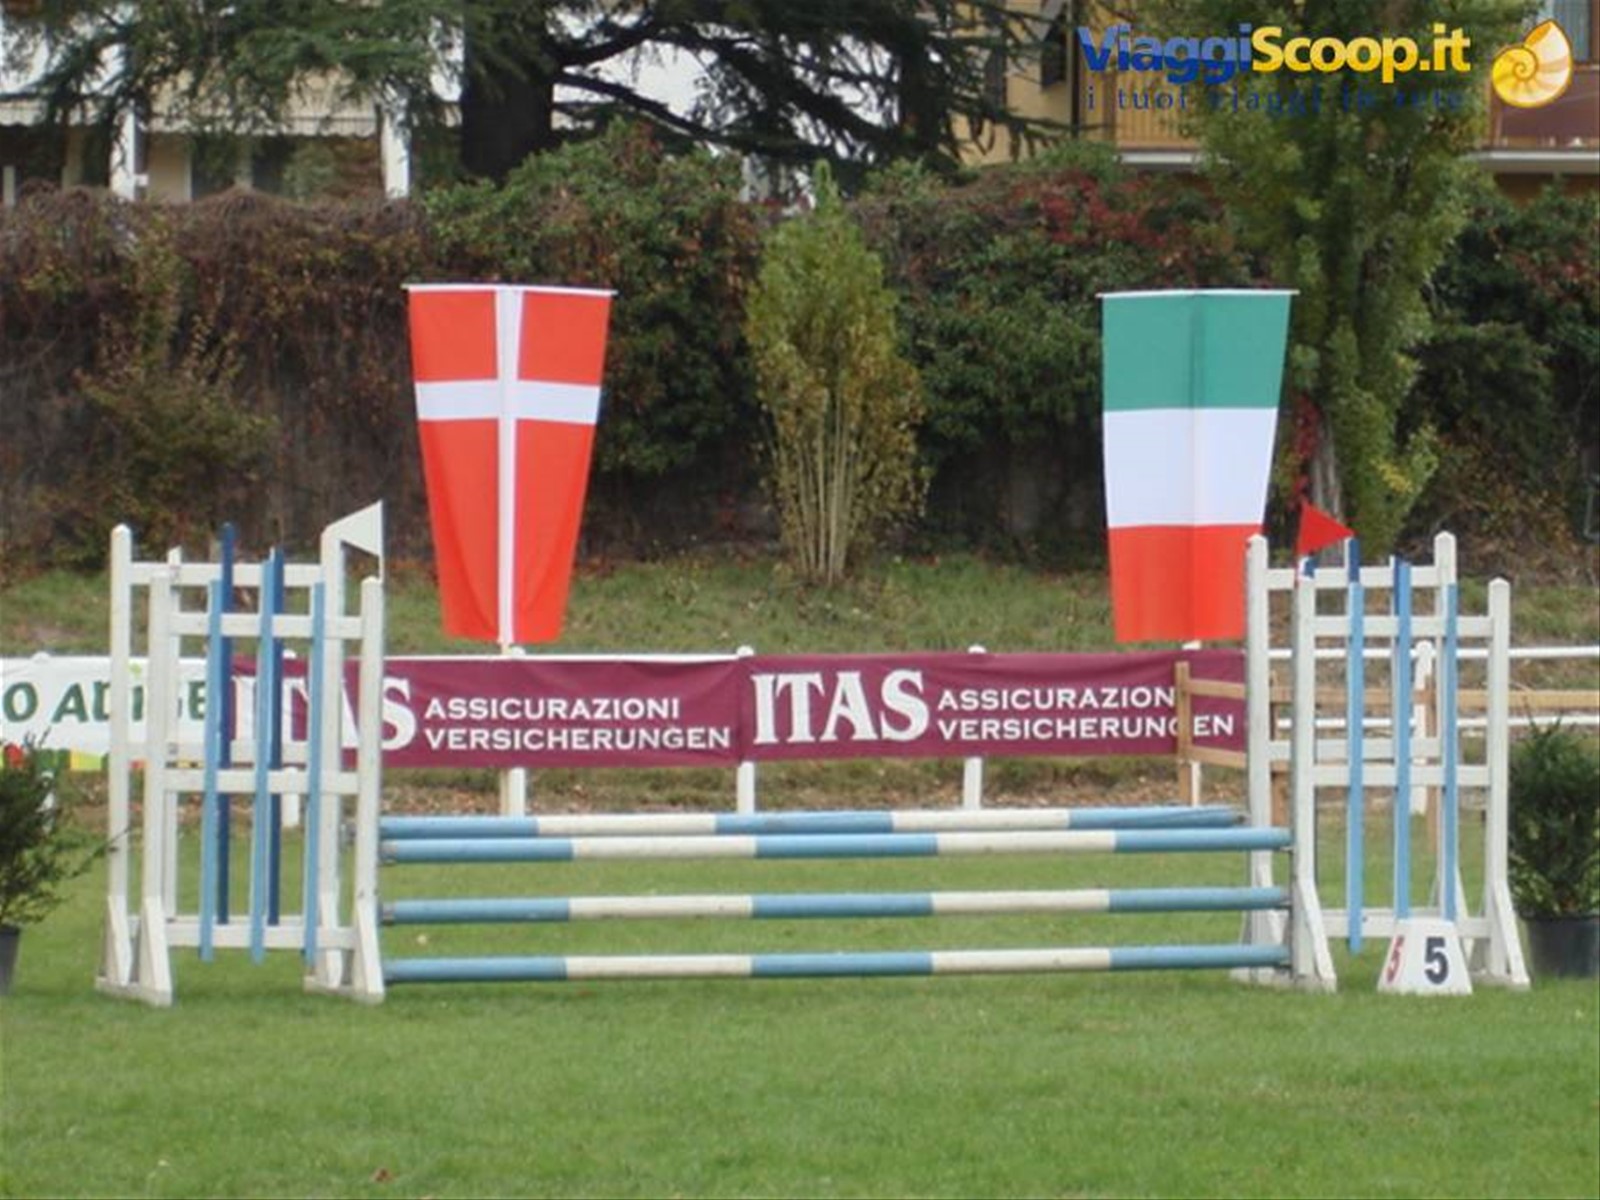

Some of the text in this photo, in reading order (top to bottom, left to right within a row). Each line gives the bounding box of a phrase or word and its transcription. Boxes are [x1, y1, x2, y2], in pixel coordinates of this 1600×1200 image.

[51, 680, 206, 724] ADIE
[424, 697, 681, 720] ASSICURAZIONI
[750, 669, 931, 745] ITAS
[936, 686, 1176, 711] ASSICURAZION
[424, 726, 731, 751] VERSICHERUNGEN
[1424, 936, 1449, 985] 5
